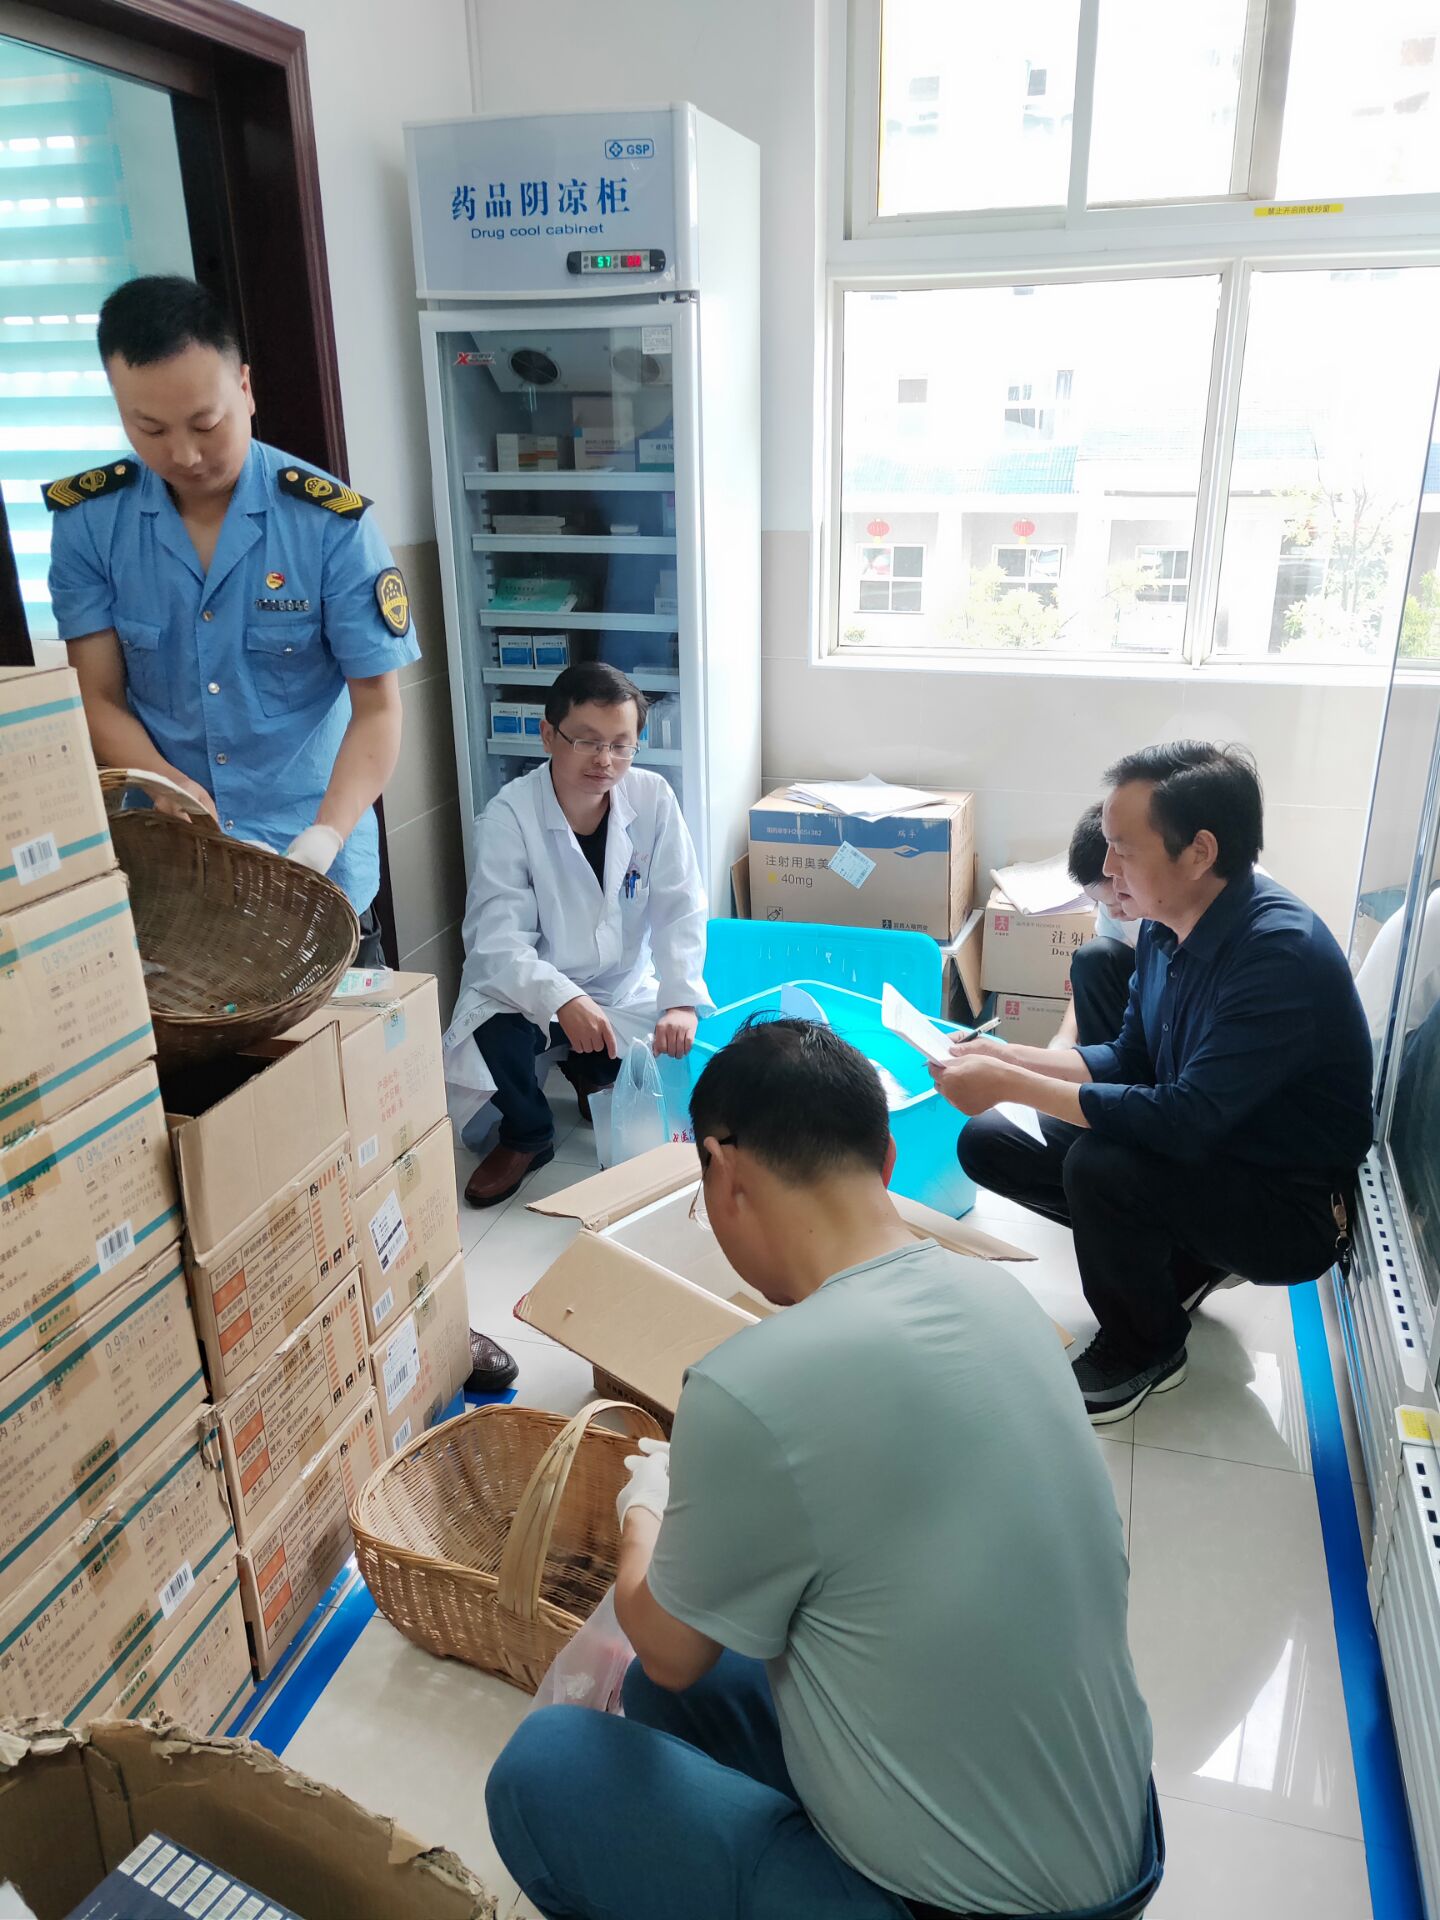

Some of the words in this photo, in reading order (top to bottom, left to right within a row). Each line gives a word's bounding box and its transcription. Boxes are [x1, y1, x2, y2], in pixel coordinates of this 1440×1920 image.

[626, 143, 650, 156] GSP
[451, 177, 630, 222] 药品阴凉柜
[471, 225, 505, 240] Drug
[510, 225, 541, 237] cool
[546, 223, 604, 235] cabinet
[781, 873, 813, 888] 40mg
